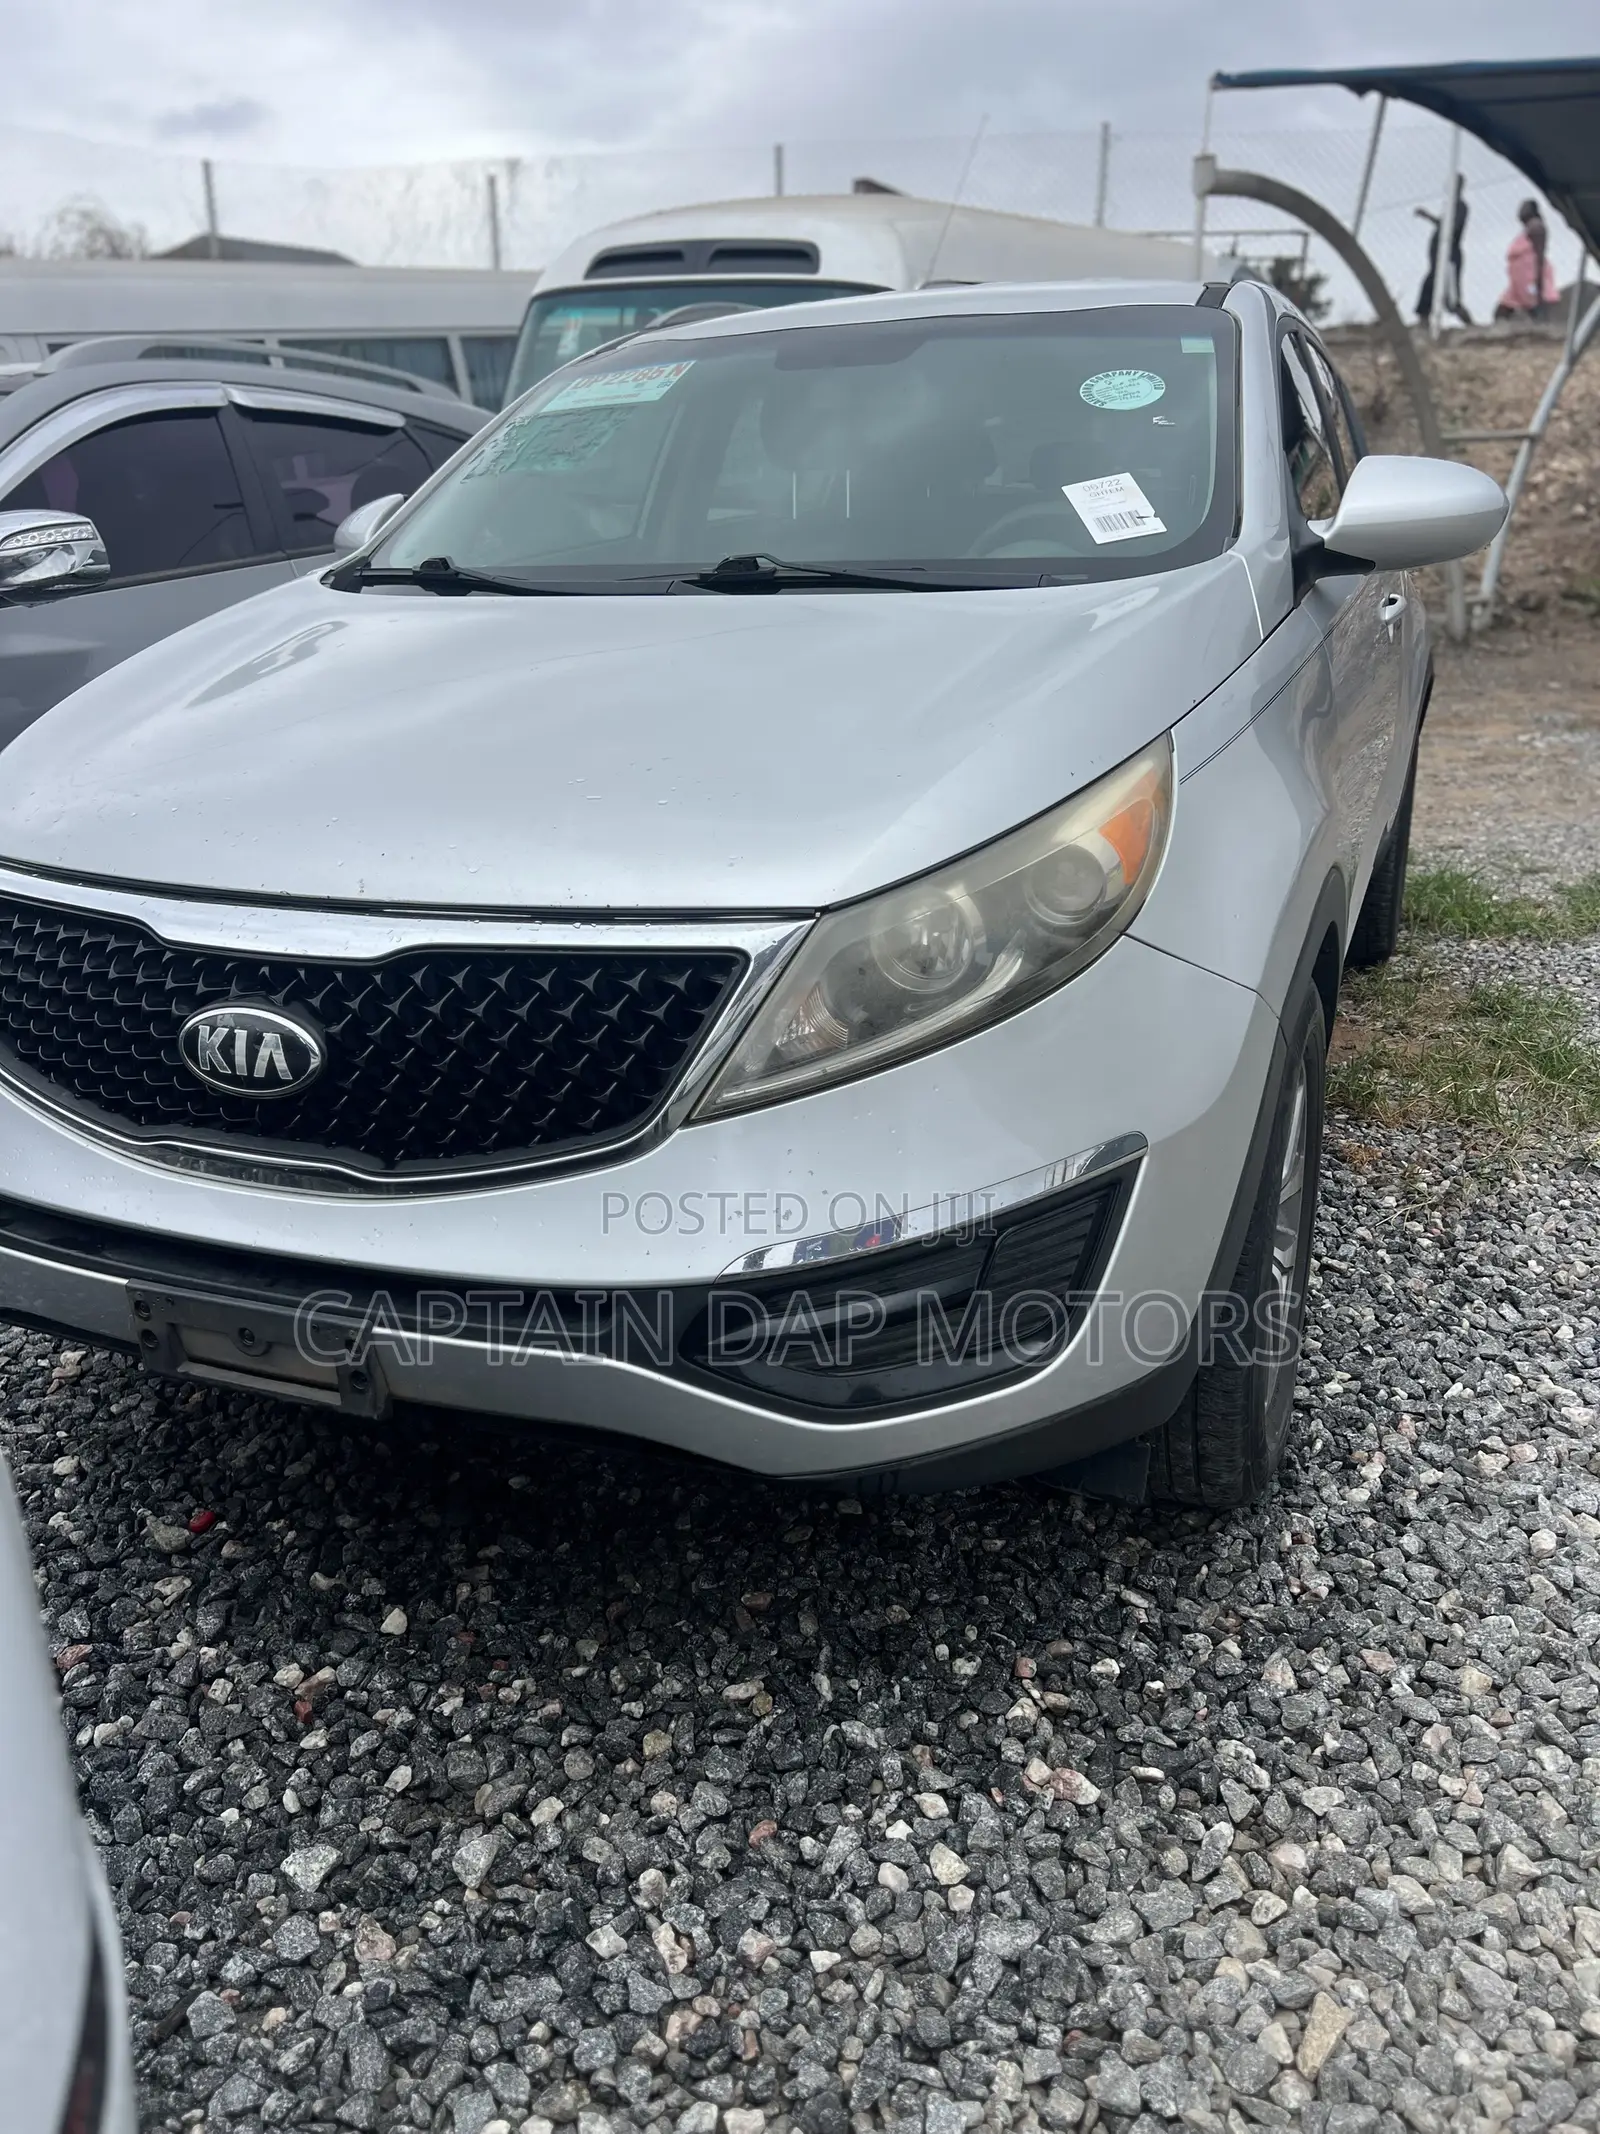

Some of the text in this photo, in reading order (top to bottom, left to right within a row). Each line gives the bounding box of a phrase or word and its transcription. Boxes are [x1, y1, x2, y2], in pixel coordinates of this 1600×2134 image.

[1089, 370, 1139, 384] COMPANY
[1138, 372, 1165, 390] LIMITED
[198, 1024, 293, 1080] KIA
